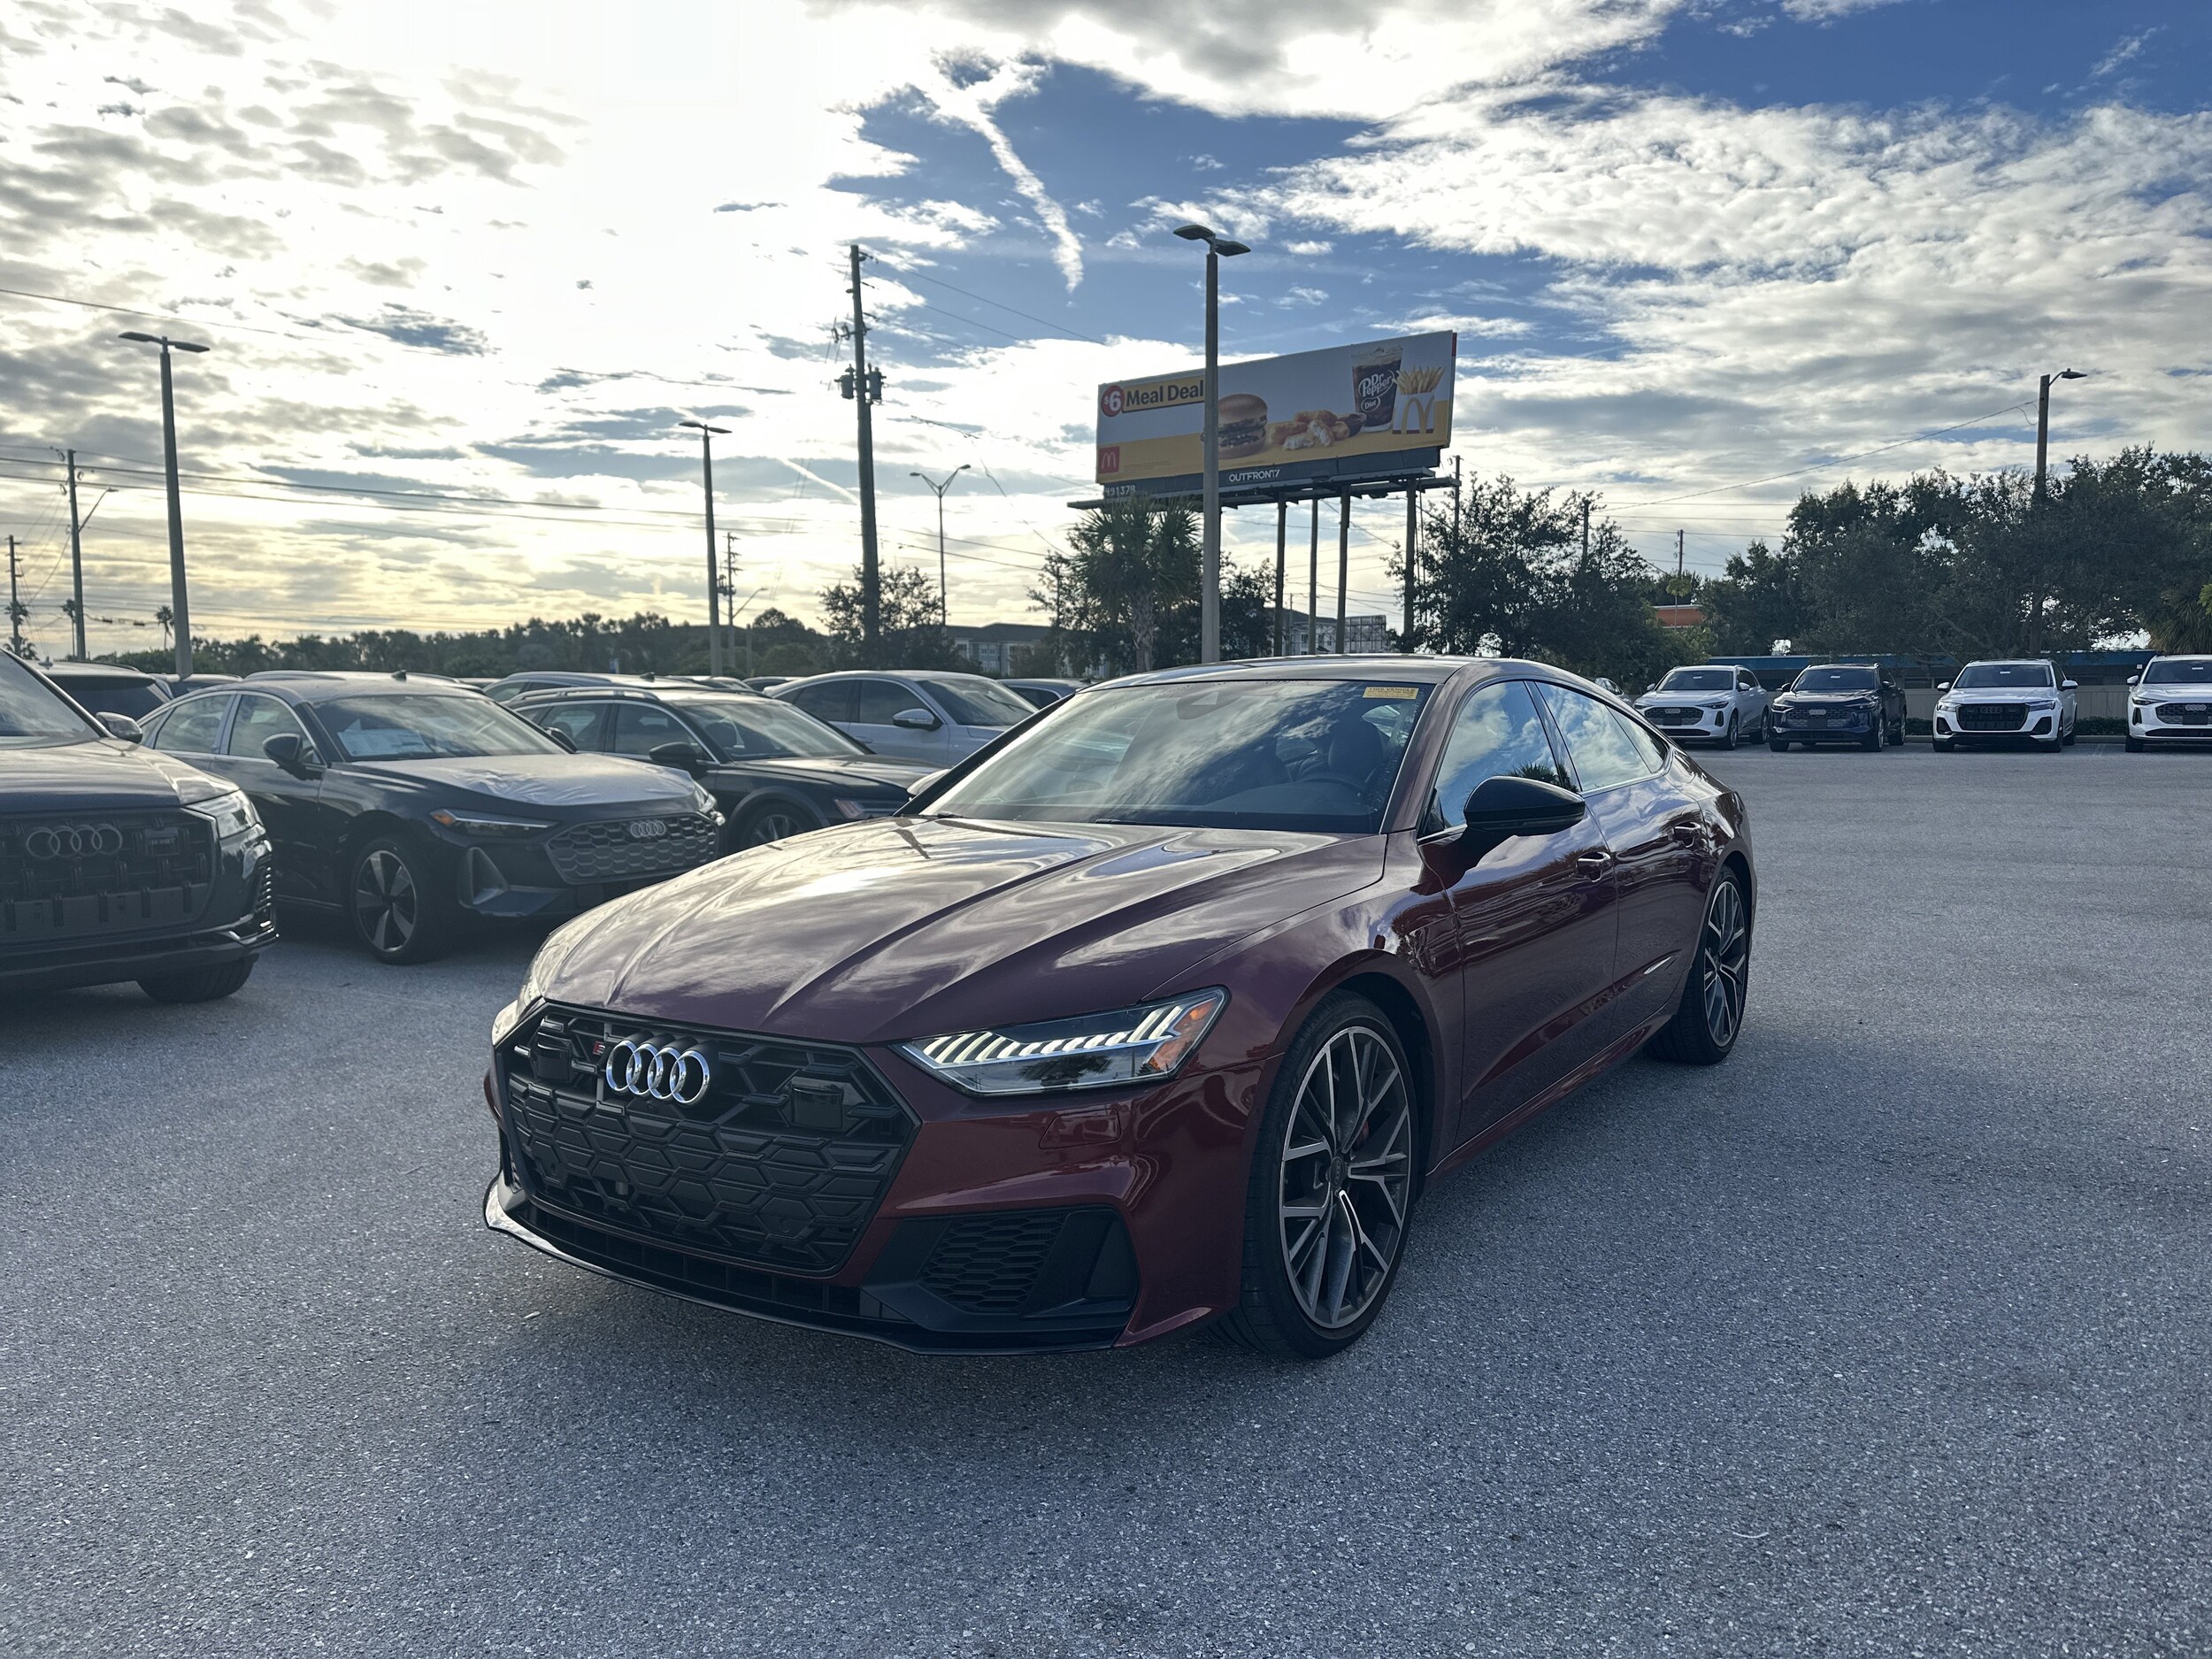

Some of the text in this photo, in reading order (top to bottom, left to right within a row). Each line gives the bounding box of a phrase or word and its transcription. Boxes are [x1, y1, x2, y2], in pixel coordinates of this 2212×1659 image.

[1362, 376, 1392, 397] Pepper
[1371, 373, 1384, 386] Dr
[1103, 380, 1204, 411] $6 Meal Deal
[1364, 399, 1377, 410] Diet
